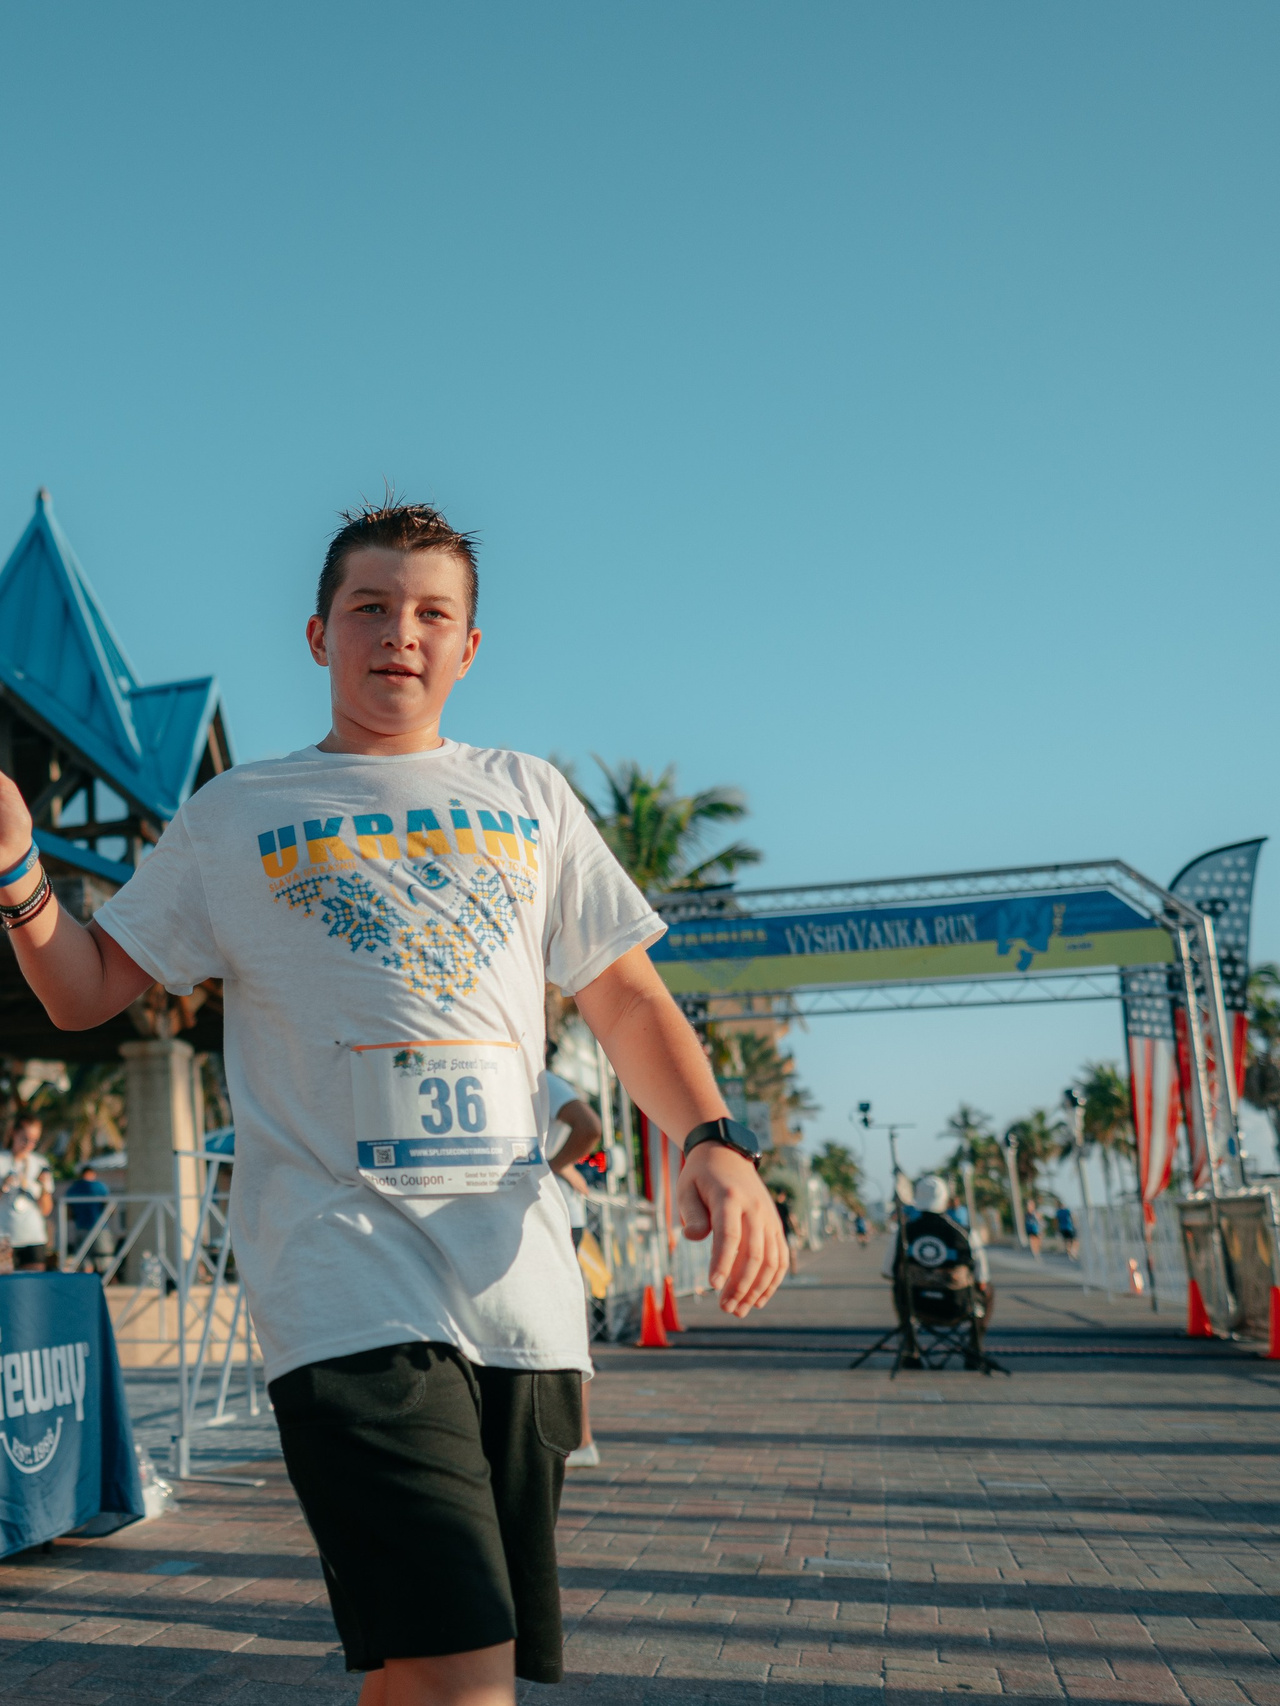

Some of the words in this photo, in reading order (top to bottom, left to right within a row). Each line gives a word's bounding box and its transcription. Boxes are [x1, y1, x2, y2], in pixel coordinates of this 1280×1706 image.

[508, 861, 520, 872] TO
[269, 872, 301, 893] SLAVA
[784, 919, 930, 955] VYSHYVANKA
[934, 912, 978, 944] RUN
[427, 1059, 447, 1073] Split
[418, 1076, 487, 1135] 36
[400, 1174, 444, 1188] Coupon
